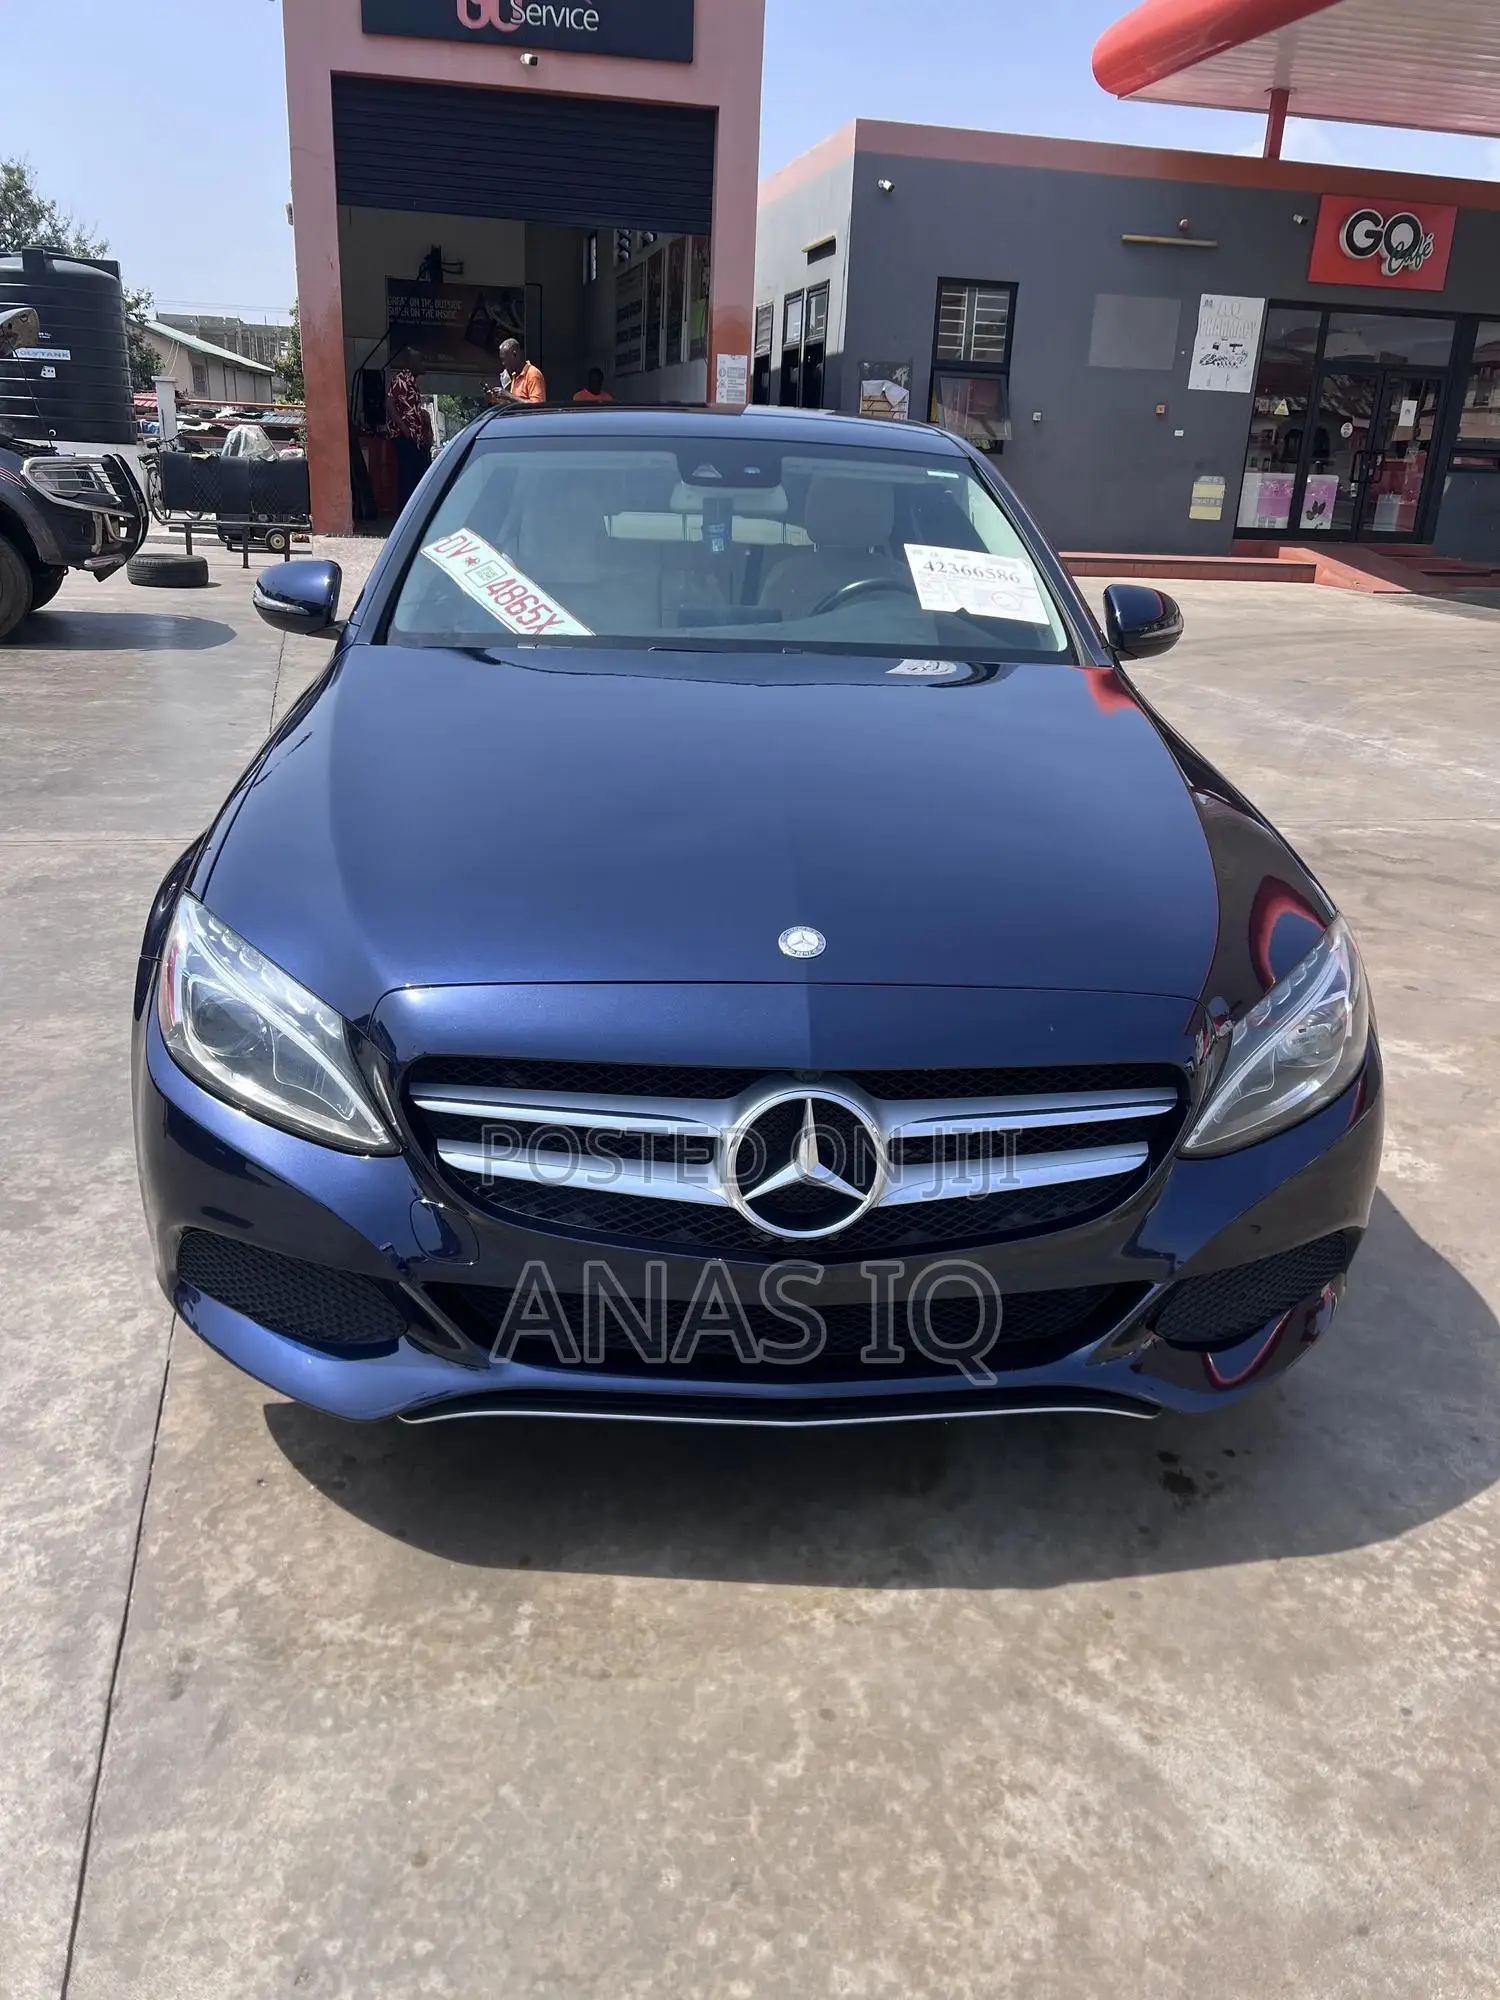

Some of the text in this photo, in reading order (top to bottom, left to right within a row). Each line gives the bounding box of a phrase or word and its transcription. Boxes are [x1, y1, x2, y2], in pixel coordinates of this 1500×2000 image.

[510, 0, 599, 31] Service
[1385, 232, 1434, 275] Café
[16, 350, 69, 358] OLYTANK
[923, 559, 1021, 584] 42366586
[486, 578, 565, 634] 4865X
